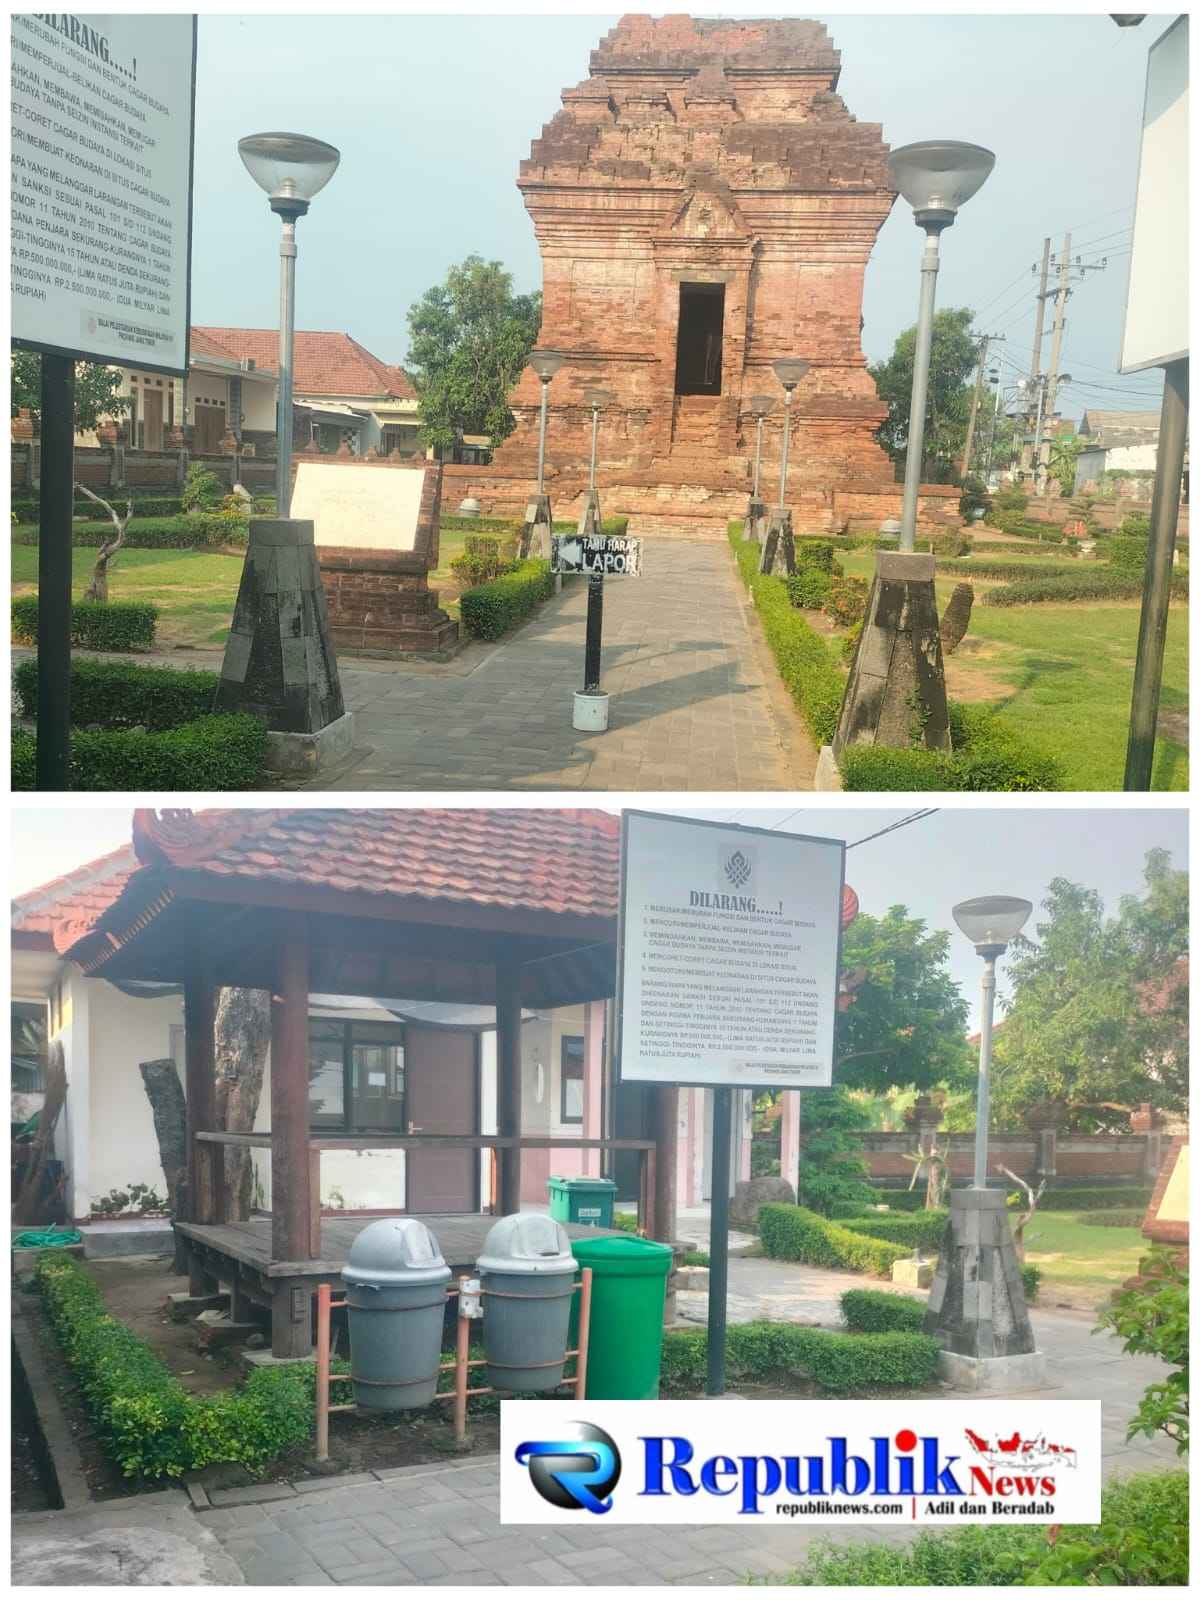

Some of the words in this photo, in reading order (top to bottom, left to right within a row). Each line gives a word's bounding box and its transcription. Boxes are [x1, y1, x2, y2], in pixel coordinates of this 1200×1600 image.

[32, 14, 138, 82] ILARANG.....!
[79, 134, 105, 156] BUDAYA
[26, 158, 48, 178] YANG
[49, 168, 94, 197] MELANGGAR
[22, 175, 52, 197] SANKSI
[85, 201, 106, 218] PASAL
[51, 205, 76, 224] TAHUN
[36, 217, 69, 238] PENJARA
[77, 249, 99, 265] TAHUN
[582, 538, 606, 551] TAMU
[607, 539, 638, 552] HARAP
[582, 553, 638, 574] LAPOR
